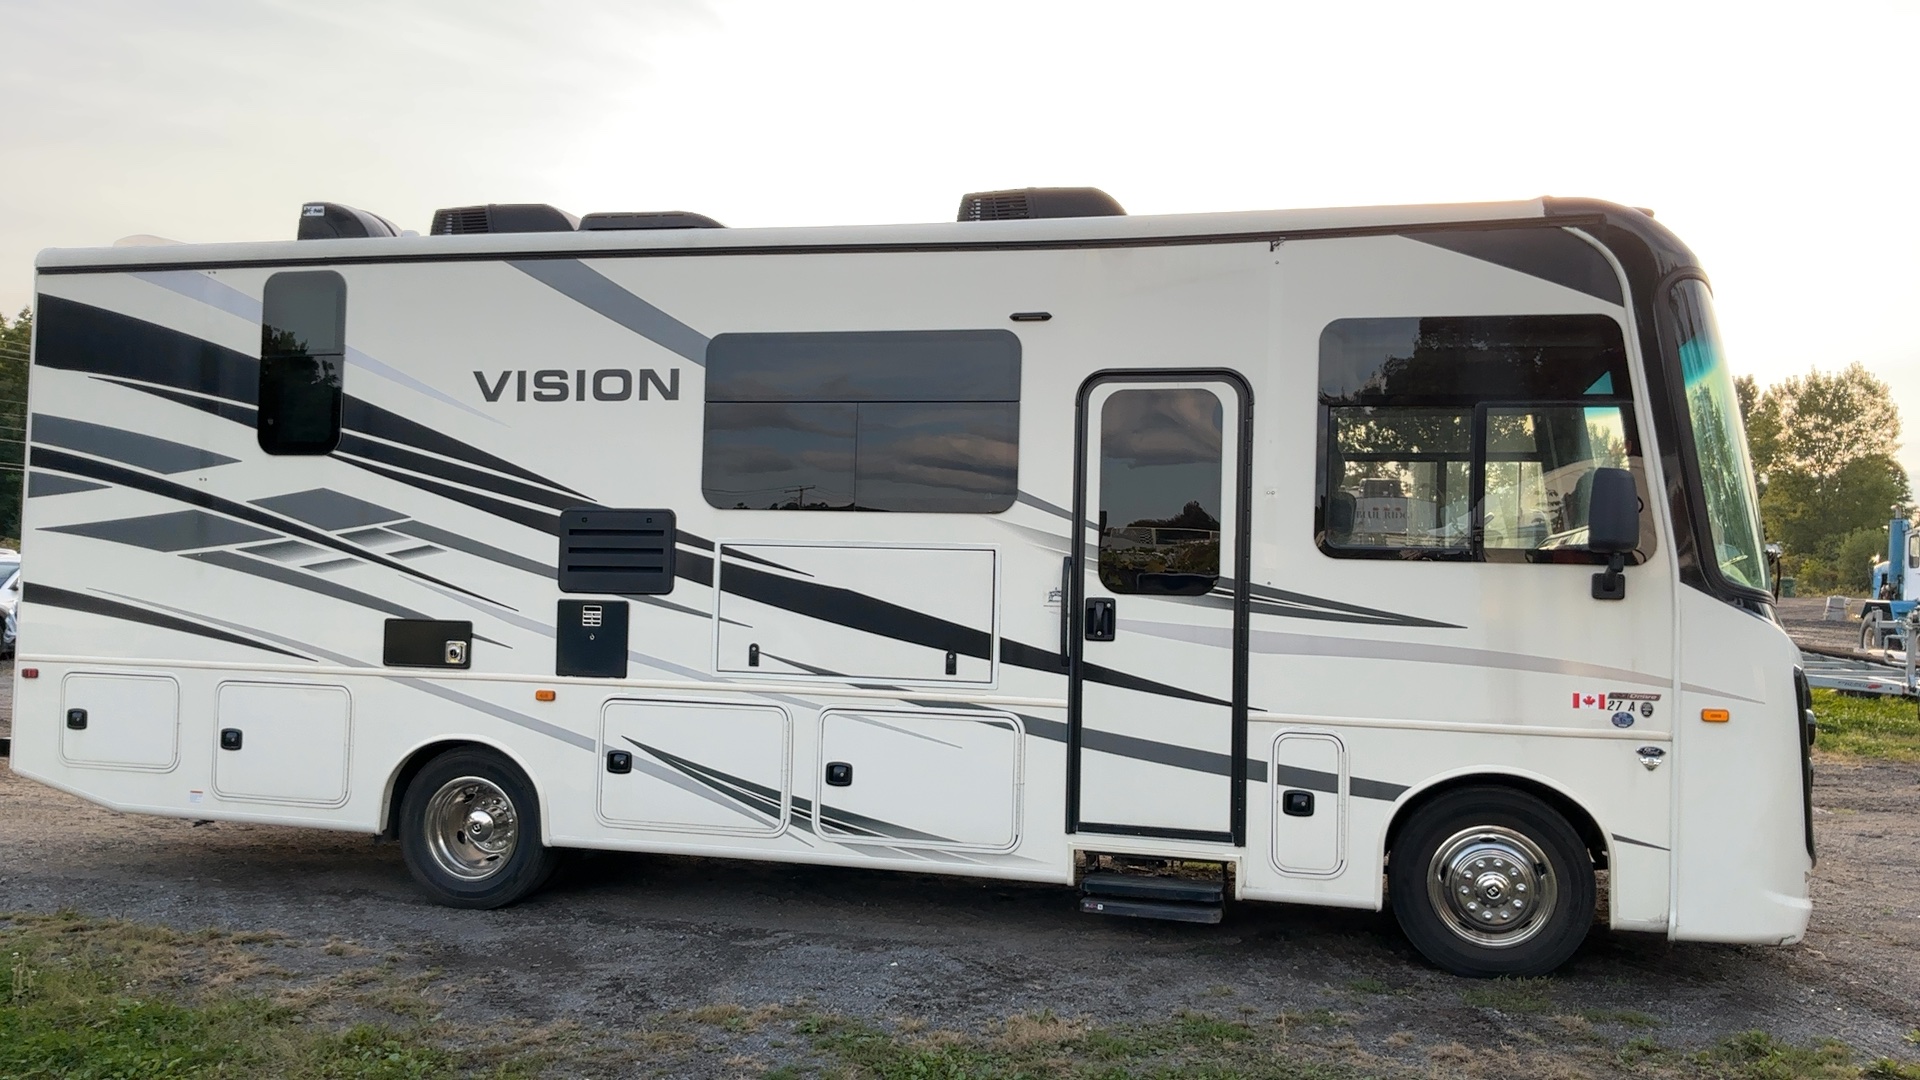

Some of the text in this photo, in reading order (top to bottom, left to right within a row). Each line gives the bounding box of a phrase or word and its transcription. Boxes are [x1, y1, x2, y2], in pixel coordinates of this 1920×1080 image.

[473, 368, 680, 402] VISION
[1607, 700, 1623, 711] 27
[1628, 701, 1635, 712] A
